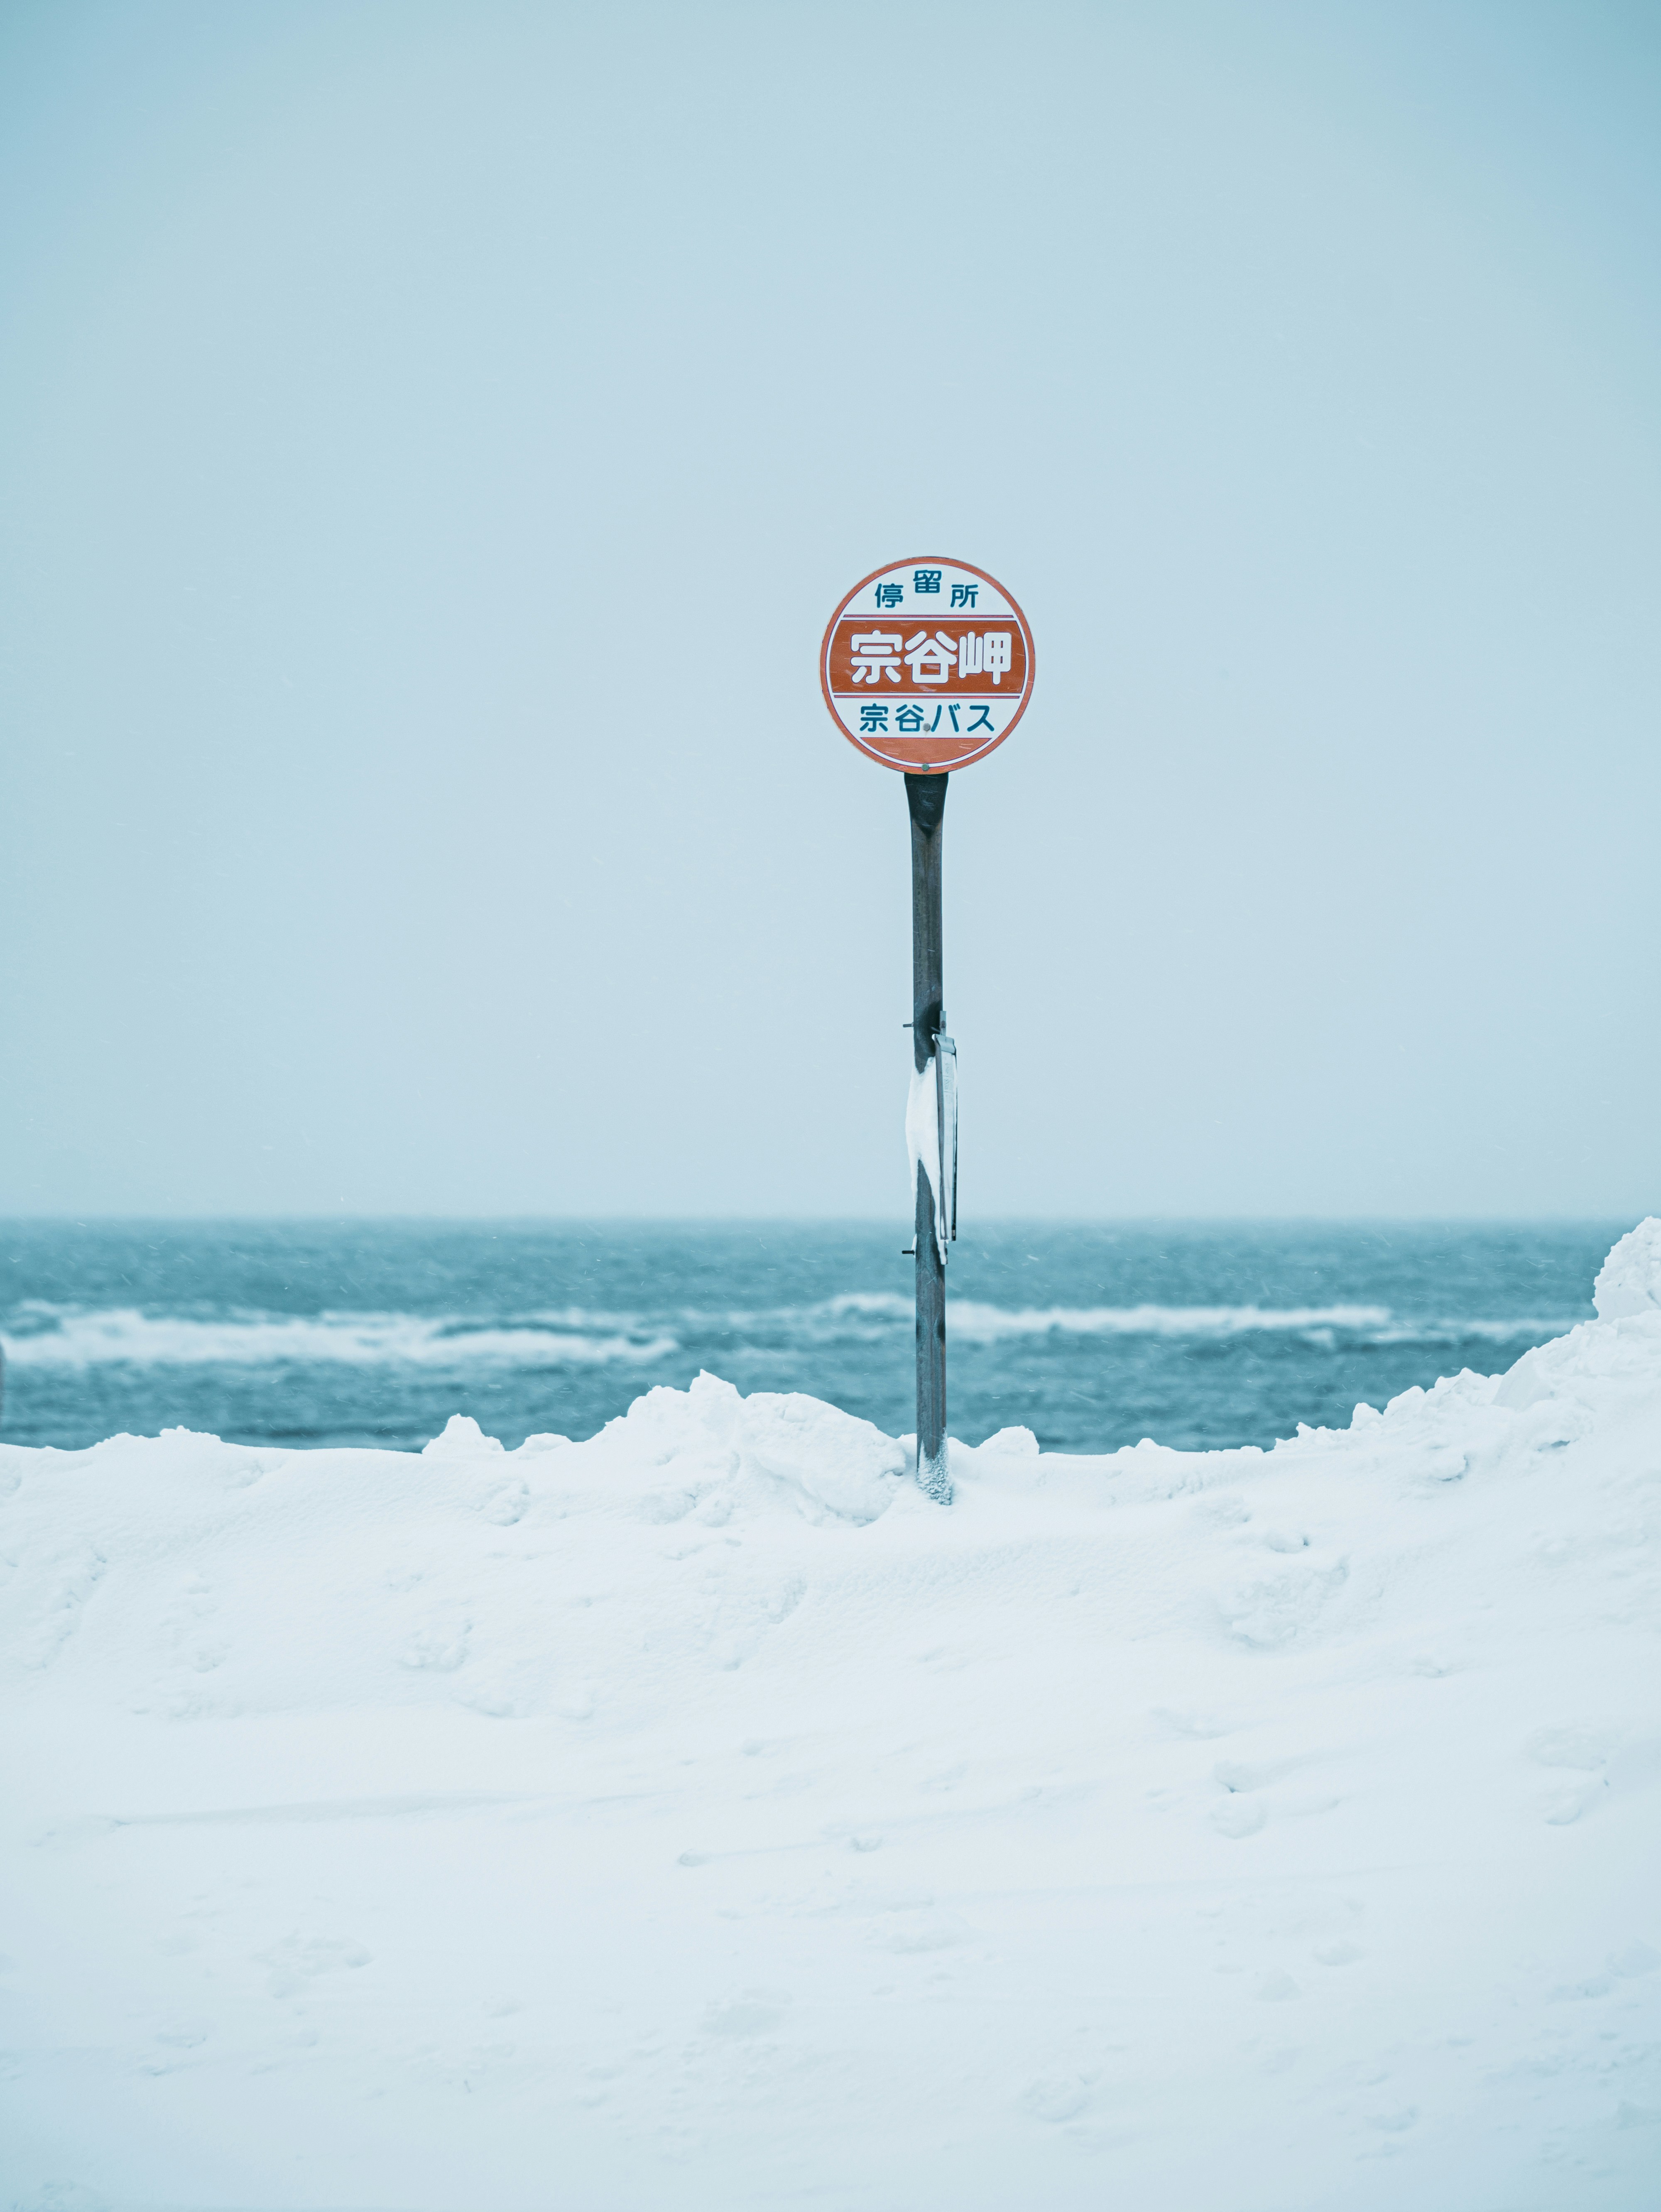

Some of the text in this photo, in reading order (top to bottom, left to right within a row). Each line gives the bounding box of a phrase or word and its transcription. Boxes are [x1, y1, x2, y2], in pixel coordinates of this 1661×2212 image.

[875, 570, 978, 608] 停留所
[851, 630, 1012, 685] 宗谷岬
[860, 703, 995, 732] 宗谷バス
